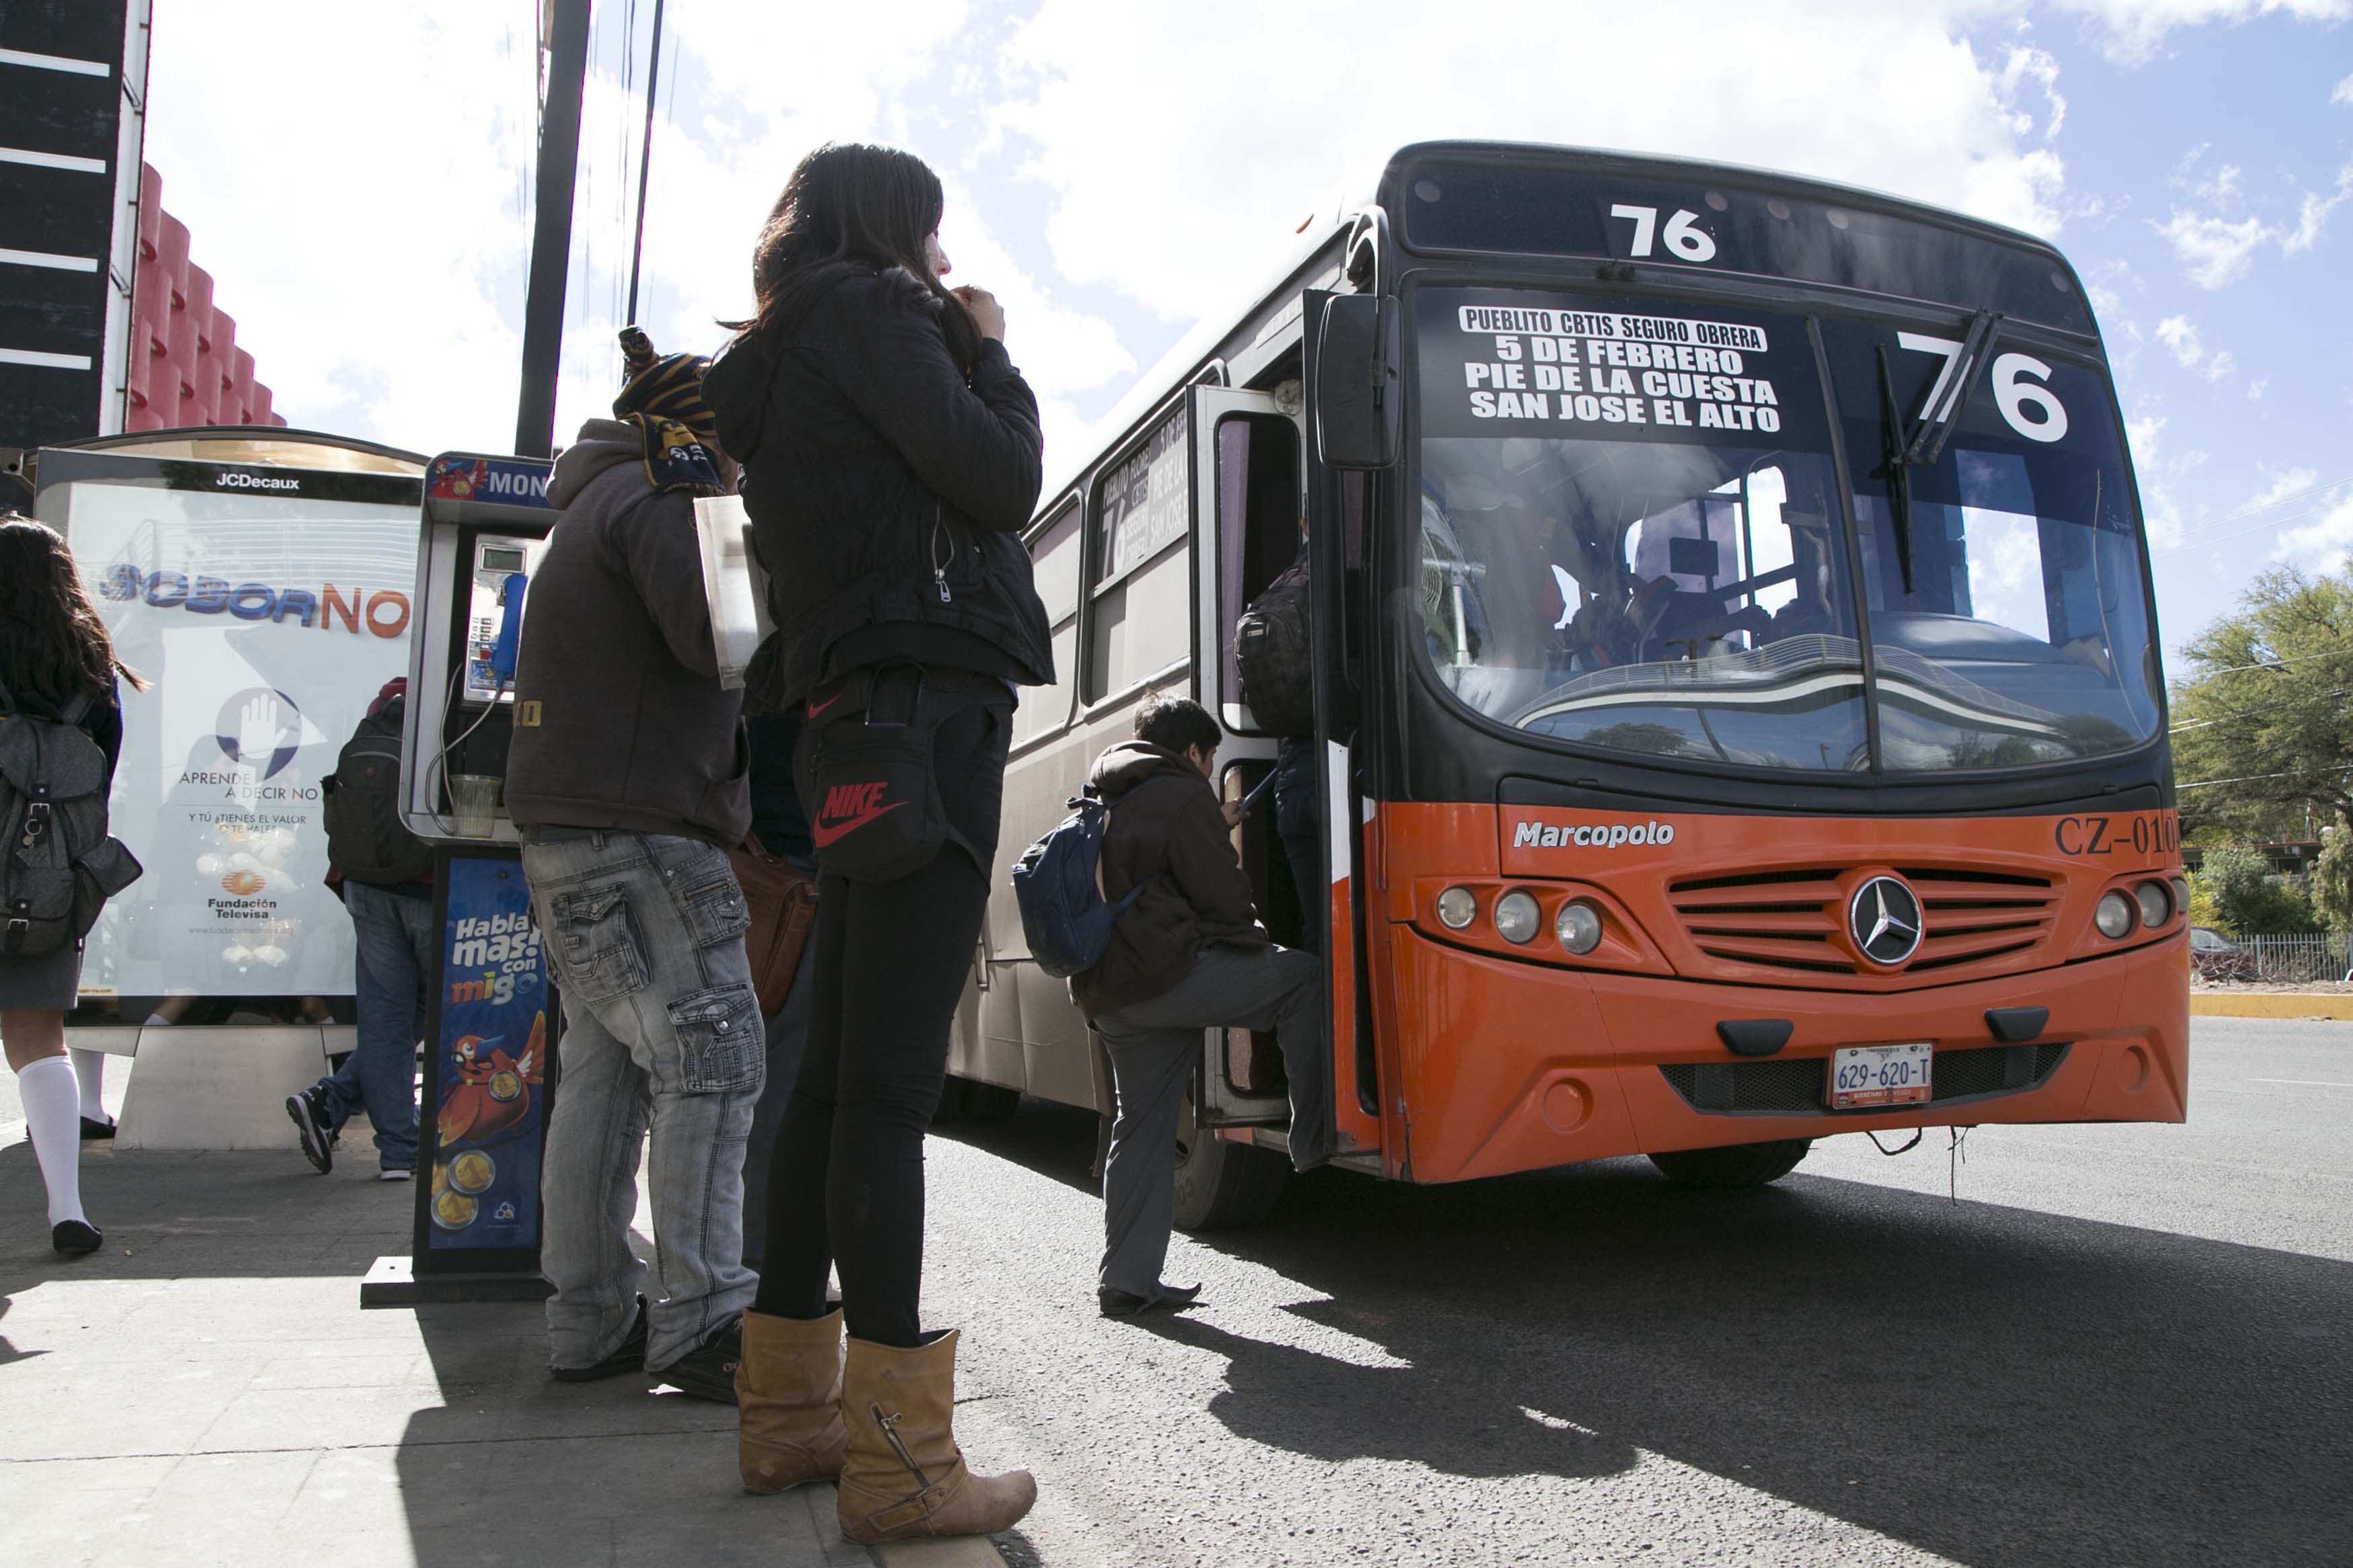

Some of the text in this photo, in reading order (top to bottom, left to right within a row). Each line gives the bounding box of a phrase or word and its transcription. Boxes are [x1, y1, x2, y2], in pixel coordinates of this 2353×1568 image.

[1611, 204, 1716, 262] 76
[1466, 309, 1761, 349] PUEBLITO CBTIS SEGURO OBRERA
[1495, 335, 1744, 375] 5 DE FEBRERO
[1465, 363, 1778, 405] PIE DE LA CUESTA
[1897, 331, 2068, 443] 76
[1470, 392, 1780, 433] SAN JOSE EL ALTO
[216, 473, 299, 489] JCDecaux
[1103, 497, 1125, 582] 76
[179, 772, 251, 785] APRENDE
[225, 787, 318, 800] A DECIR NO
[822, 781, 888, 819] NIKE
[189, 811, 307, 824] Y TÚ ¿TIENES EL VALOR
[219, 825, 229, 833] O
[232, 825, 242, 833] TE
[1513, 820, 1675, 849] Marcopolo
[2055, 816, 2180, 856] CZ-010
[208, 898, 277, 908] Fundación
[215, 909, 269, 919] Televisa
[456, 912, 529, 940] Habla
[502, 958, 536, 974] con
[451, 971, 539, 1005] migo
[1838, 1059, 1929, 1089] 629-620-T
